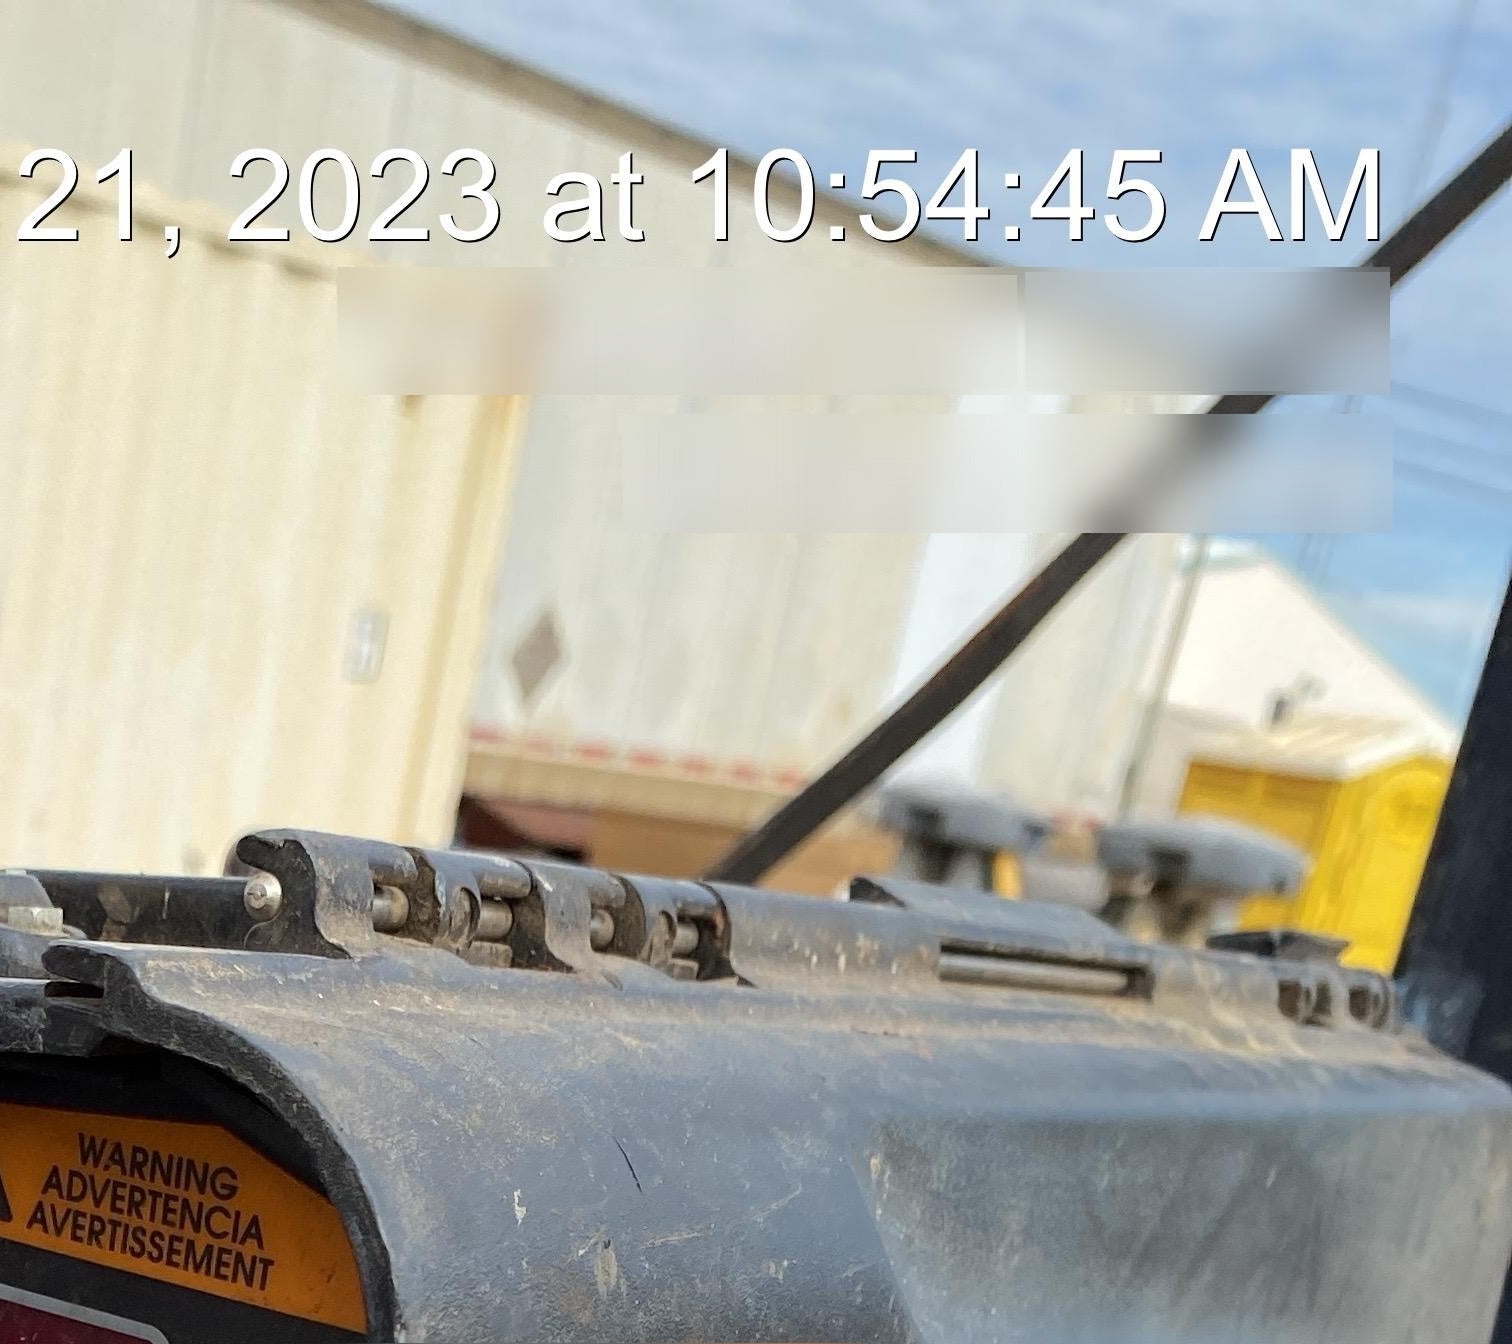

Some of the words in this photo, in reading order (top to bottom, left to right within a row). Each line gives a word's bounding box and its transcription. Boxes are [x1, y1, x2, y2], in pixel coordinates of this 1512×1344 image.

[40, 1165, 265, 1250] ADVERTENCIA
[78, 1132, 238, 1201] WARNING
[28, 1200, 275, 1291] AVERTISSEMENT
